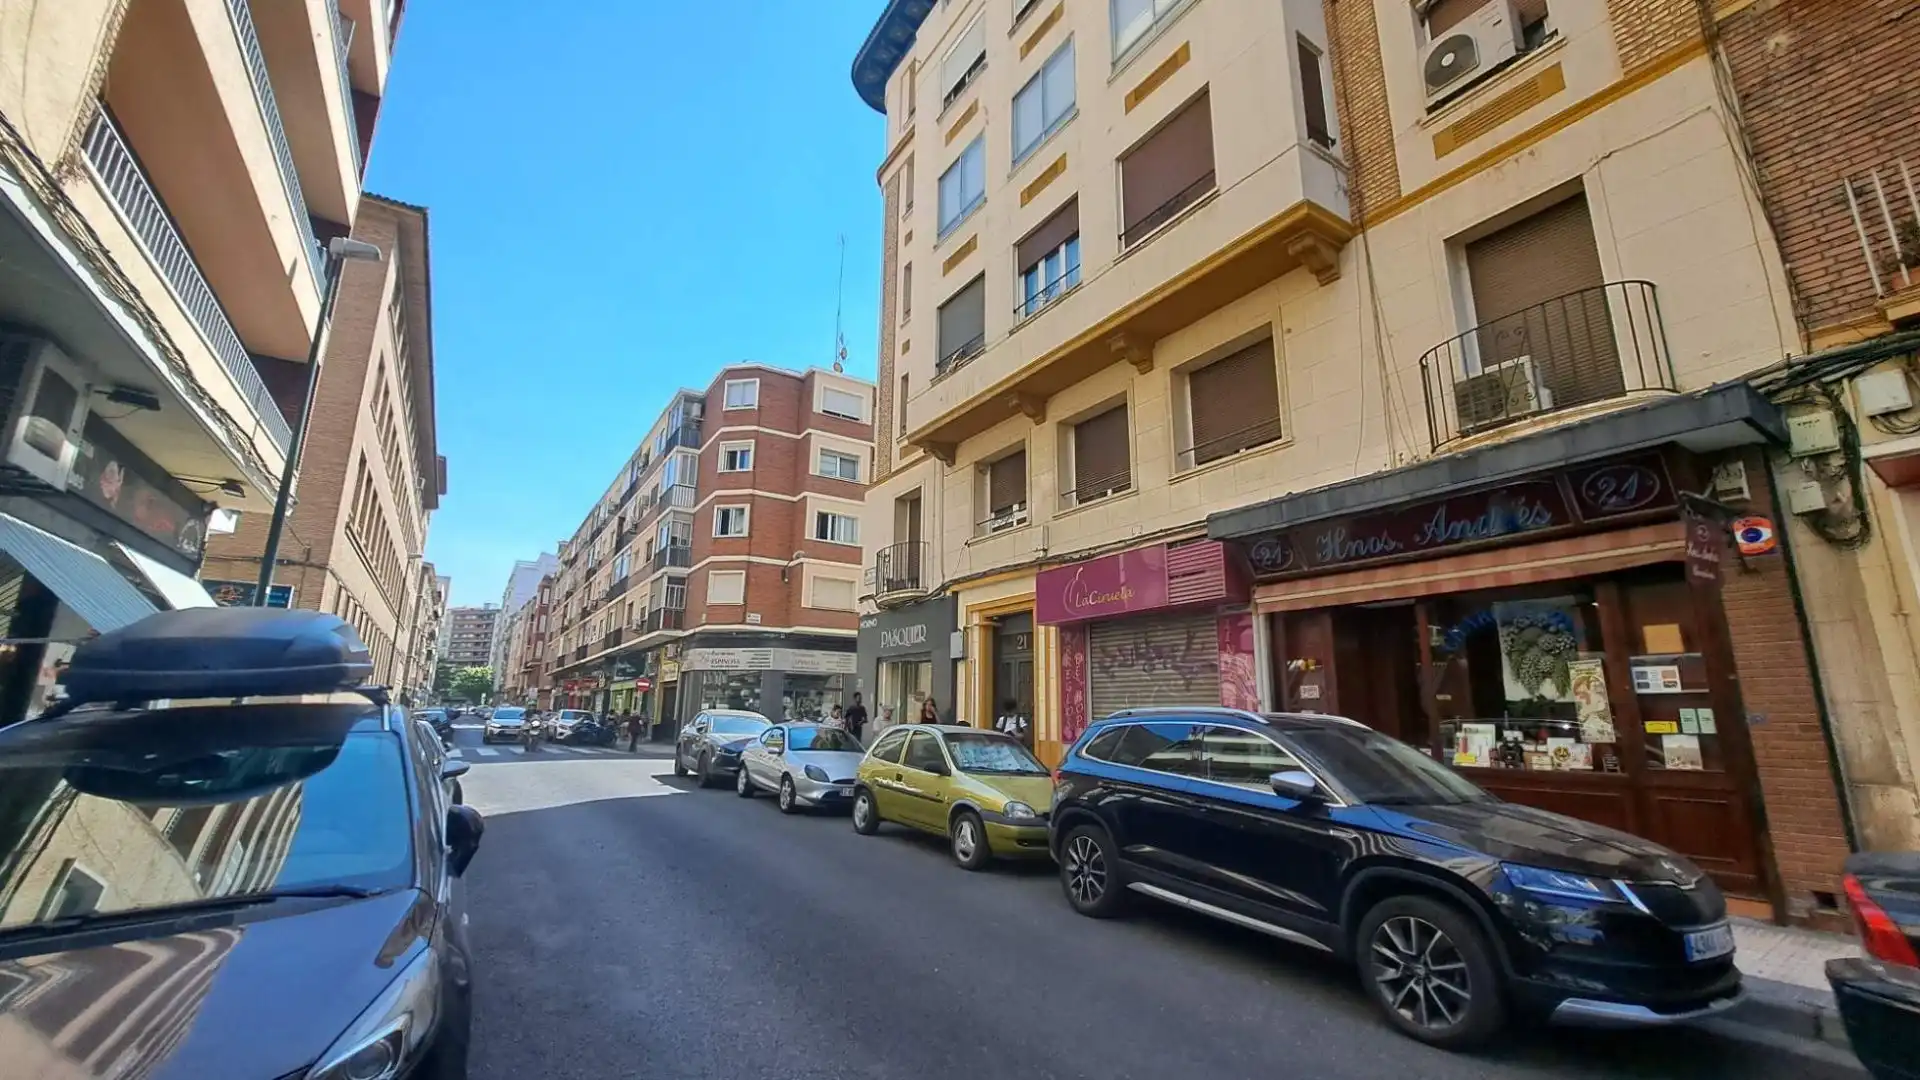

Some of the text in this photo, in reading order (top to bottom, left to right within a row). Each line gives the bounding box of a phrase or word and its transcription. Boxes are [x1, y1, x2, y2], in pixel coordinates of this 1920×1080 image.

[1598, 472, 1638, 503] 21
[1260, 546, 1283, 566] 21
[881, 624, 927, 648] PASQUIER
[1017, 634, 1027, 650] 21
